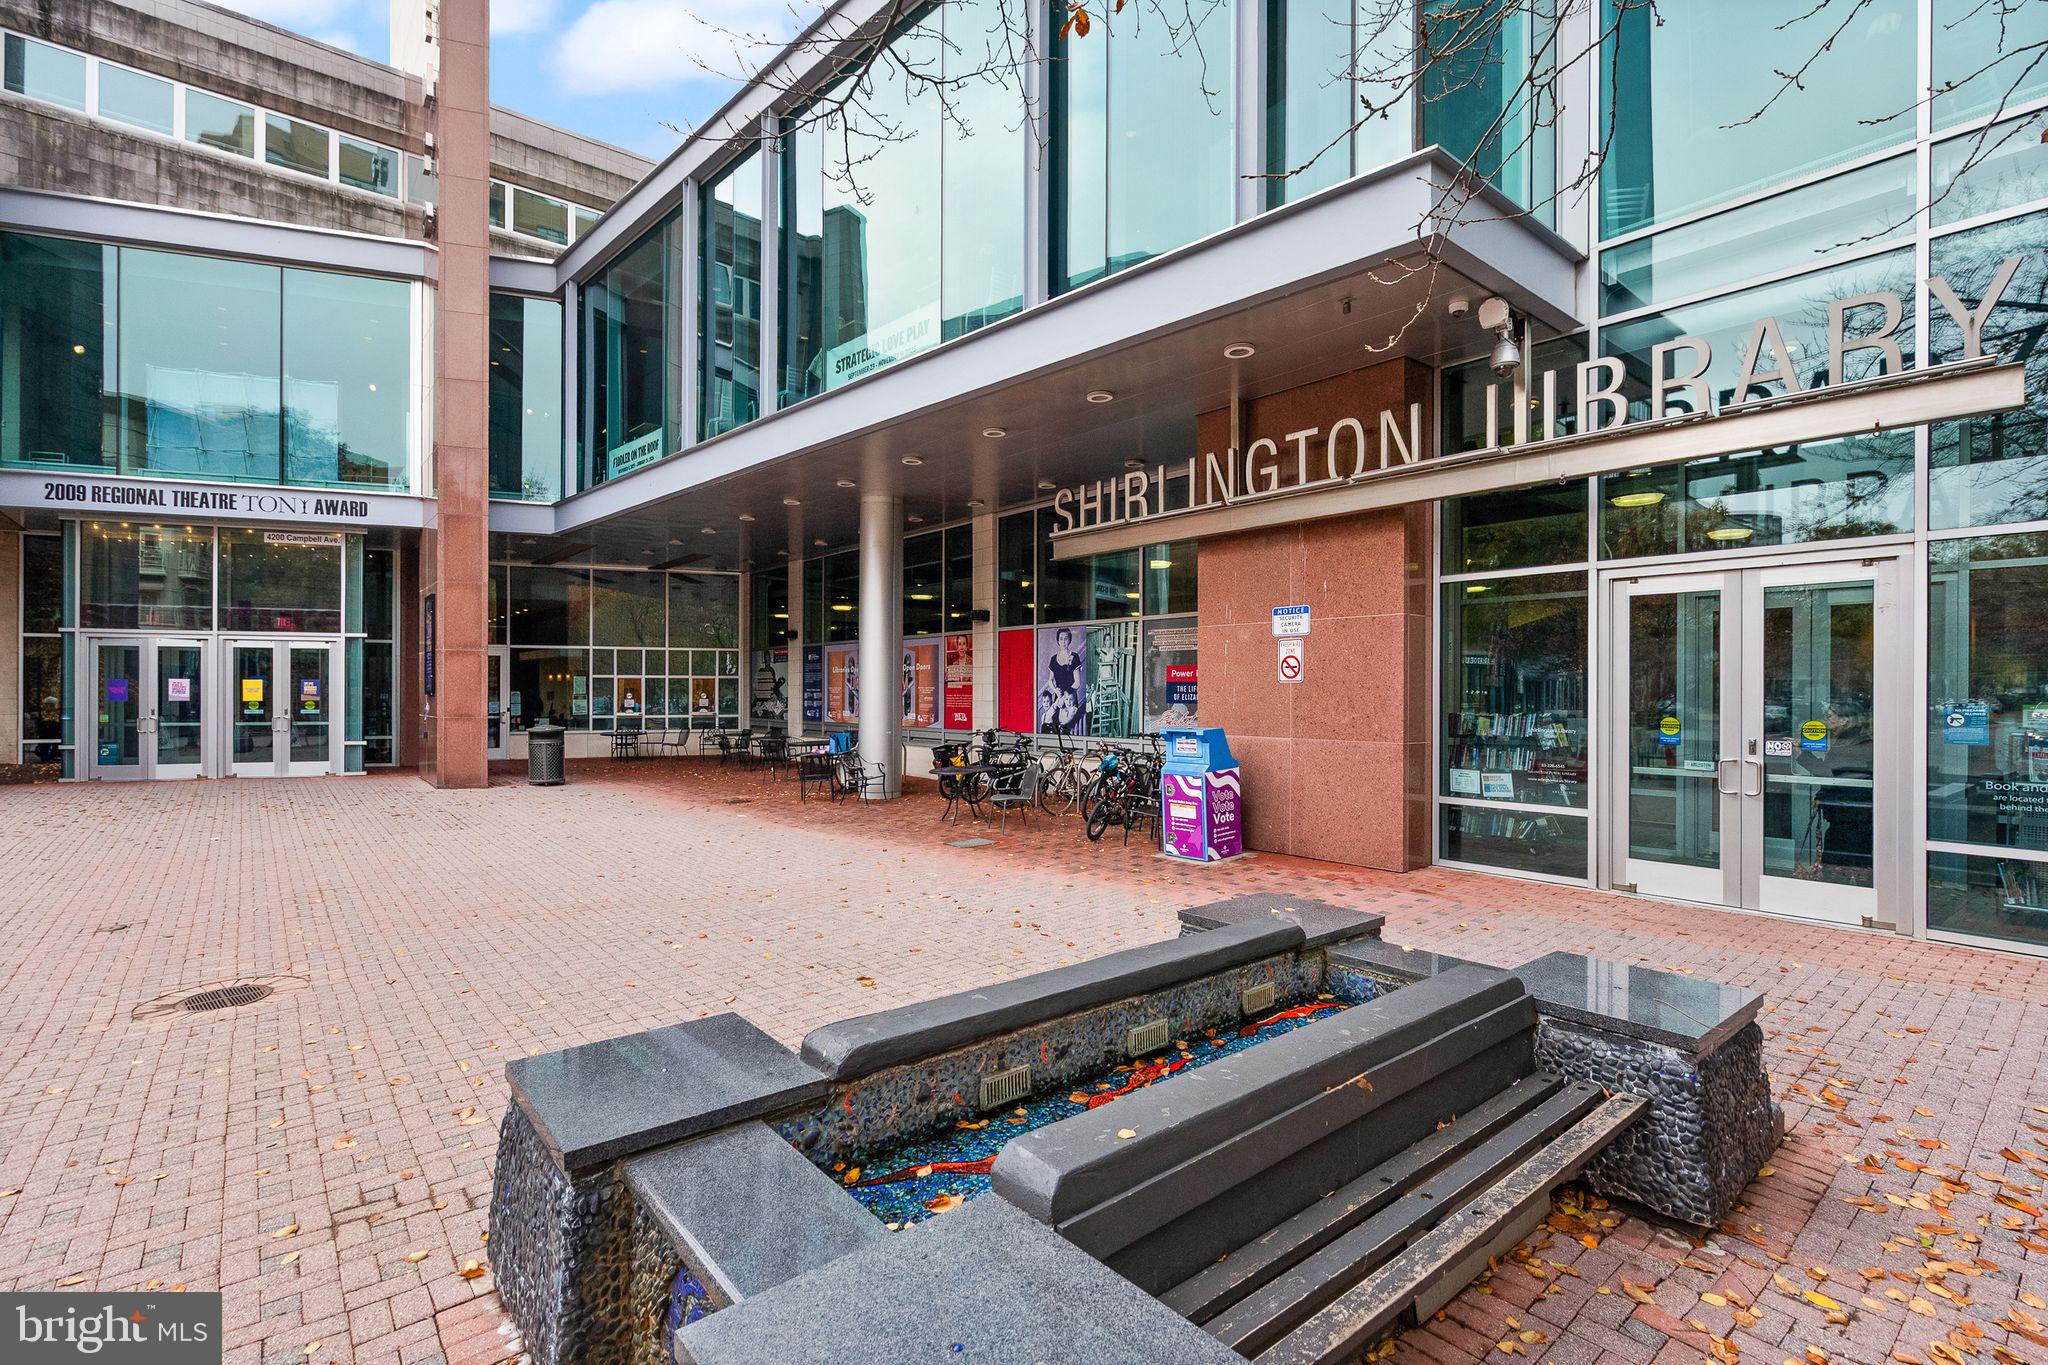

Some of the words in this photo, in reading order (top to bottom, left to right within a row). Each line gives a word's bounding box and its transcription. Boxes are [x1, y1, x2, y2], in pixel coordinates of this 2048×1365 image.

[835, 341, 880, 374] STRATEGIC
[882, 330, 905, 353] LOVE
[906, 318, 931, 343] PLAY
[630, 448, 638, 461] ON
[638, 444, 647, 458] THE
[1053, 402, 1421, 533] SHIRLINGTON
[44, 482, 87, 502] 2009
[91, 485, 167, 507] REGIONAL
[172, 490, 237, 510] THEATRE
[241, 494, 311, 515] TONY
[313, 498, 368, 517] AWARD
[266, 533, 285, 541] 4200
[286, 534, 322, 545] Campbell
[323, 535, 341, 544] Ave.
[1277, 607, 1305, 615] NOTICE
[1171, 669, 1194, 677] Power
[1177, 685, 1187, 693] THE
[1985, 780, 2019, 791] Book
[2022, 782, 2048, 793] and
[1212, 790, 1234, 802] Vote
[2009, 794, 2045, 803] located
[1212, 801, 1234, 813] Vote
[1999, 803, 2033, 812] behind
[1213, 812, 1235, 825] Vote
